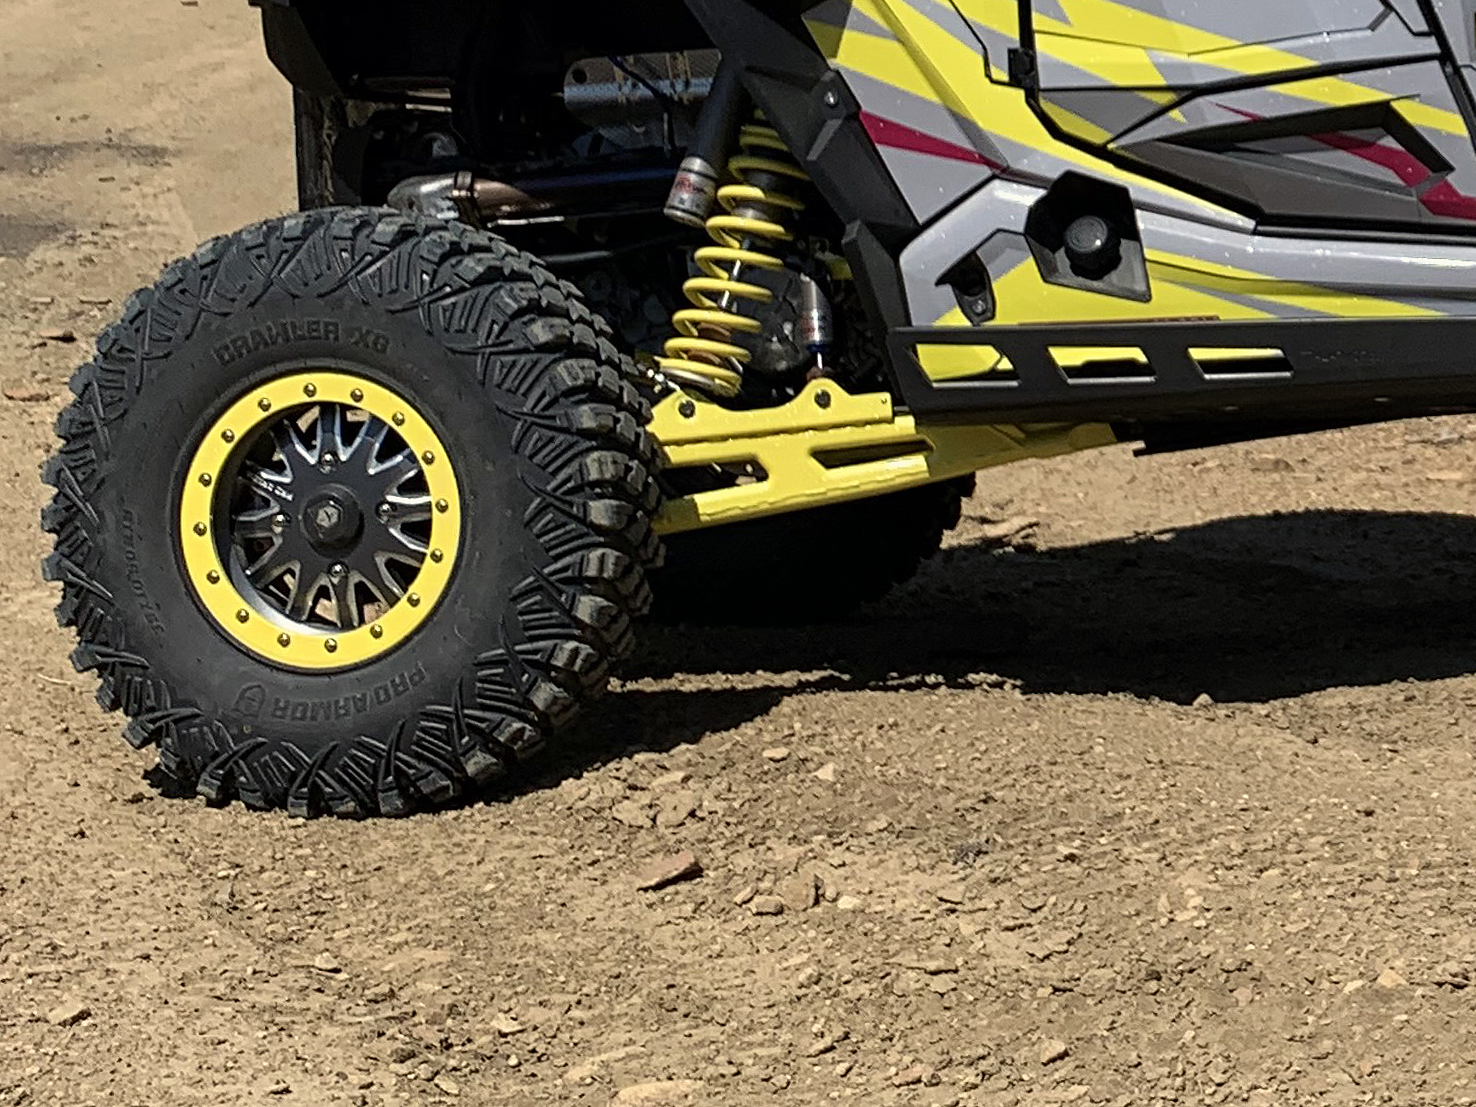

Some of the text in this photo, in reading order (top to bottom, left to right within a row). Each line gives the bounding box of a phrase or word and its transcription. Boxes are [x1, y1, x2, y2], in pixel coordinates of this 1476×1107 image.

[211, 318, 341, 368] CRAWLER
[270, 661, 428, 722] PRO ARMOR
